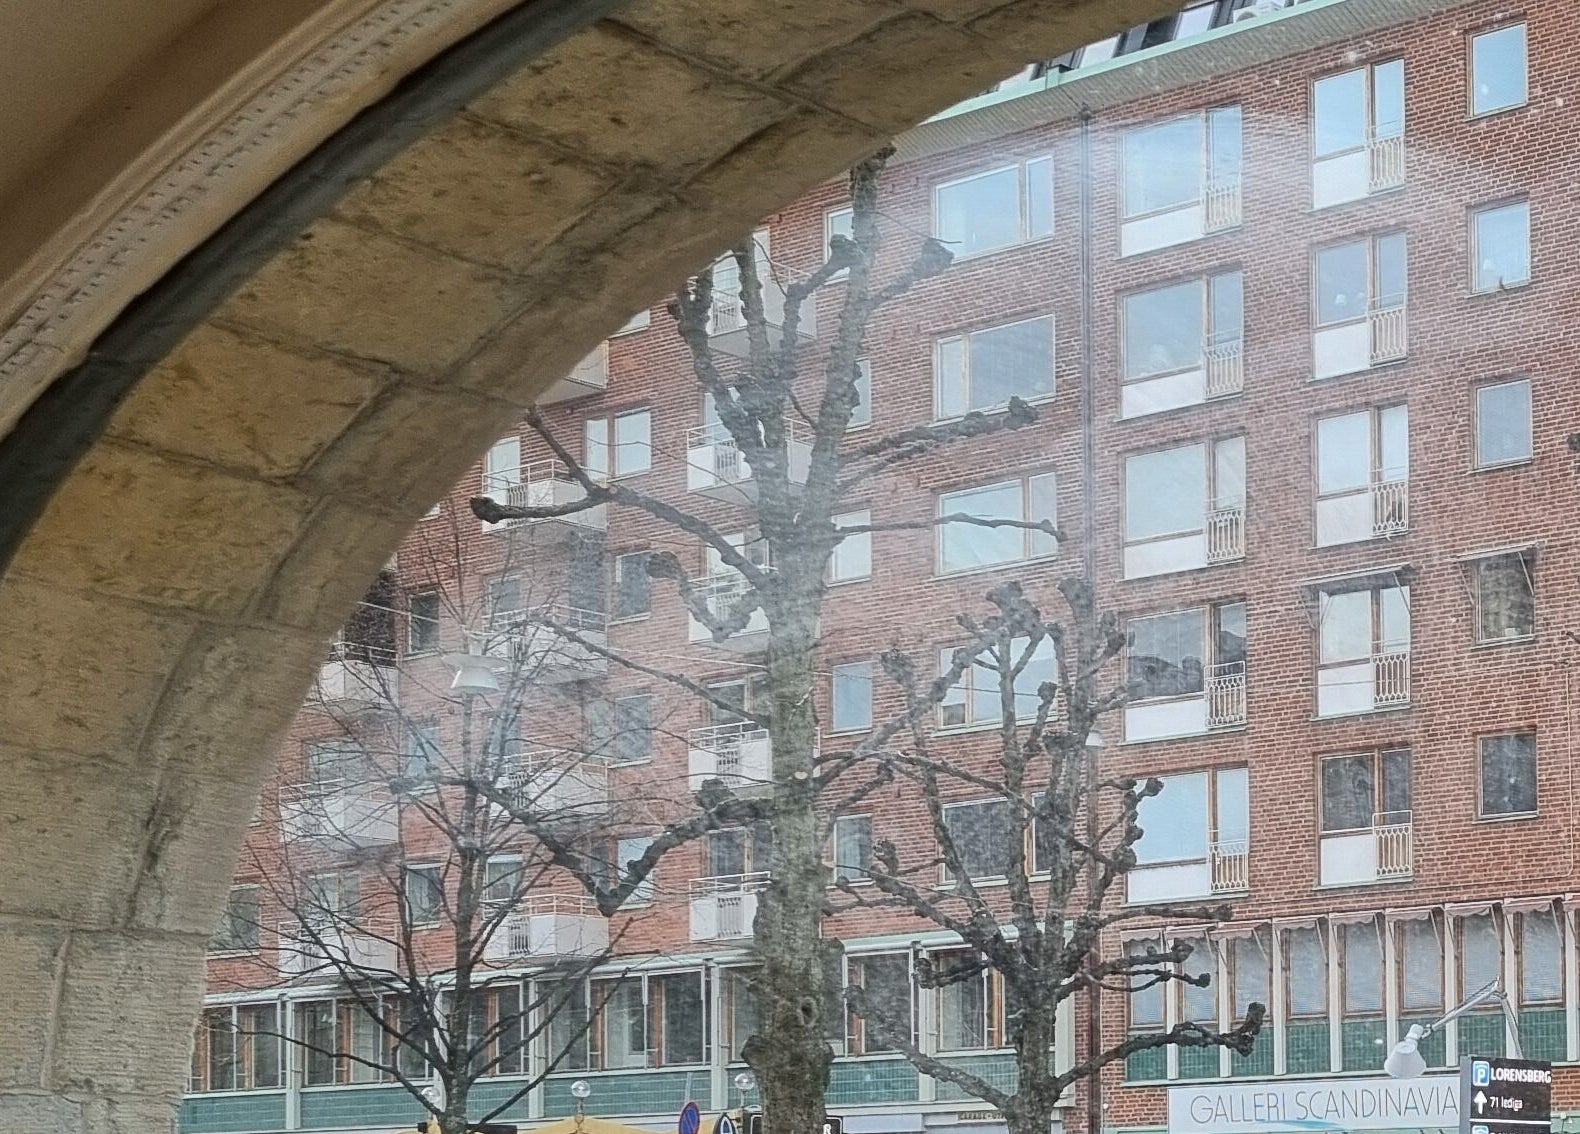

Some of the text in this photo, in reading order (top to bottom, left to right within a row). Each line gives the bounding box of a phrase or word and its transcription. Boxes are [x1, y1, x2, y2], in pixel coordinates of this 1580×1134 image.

[1490, 1067, 1552, 1084] LORENSBERG
[1190, 1085, 1459, 1123] GALLERI SCANDINAVIA
[1490, 1096, 1523, 1111] 71 lediga
